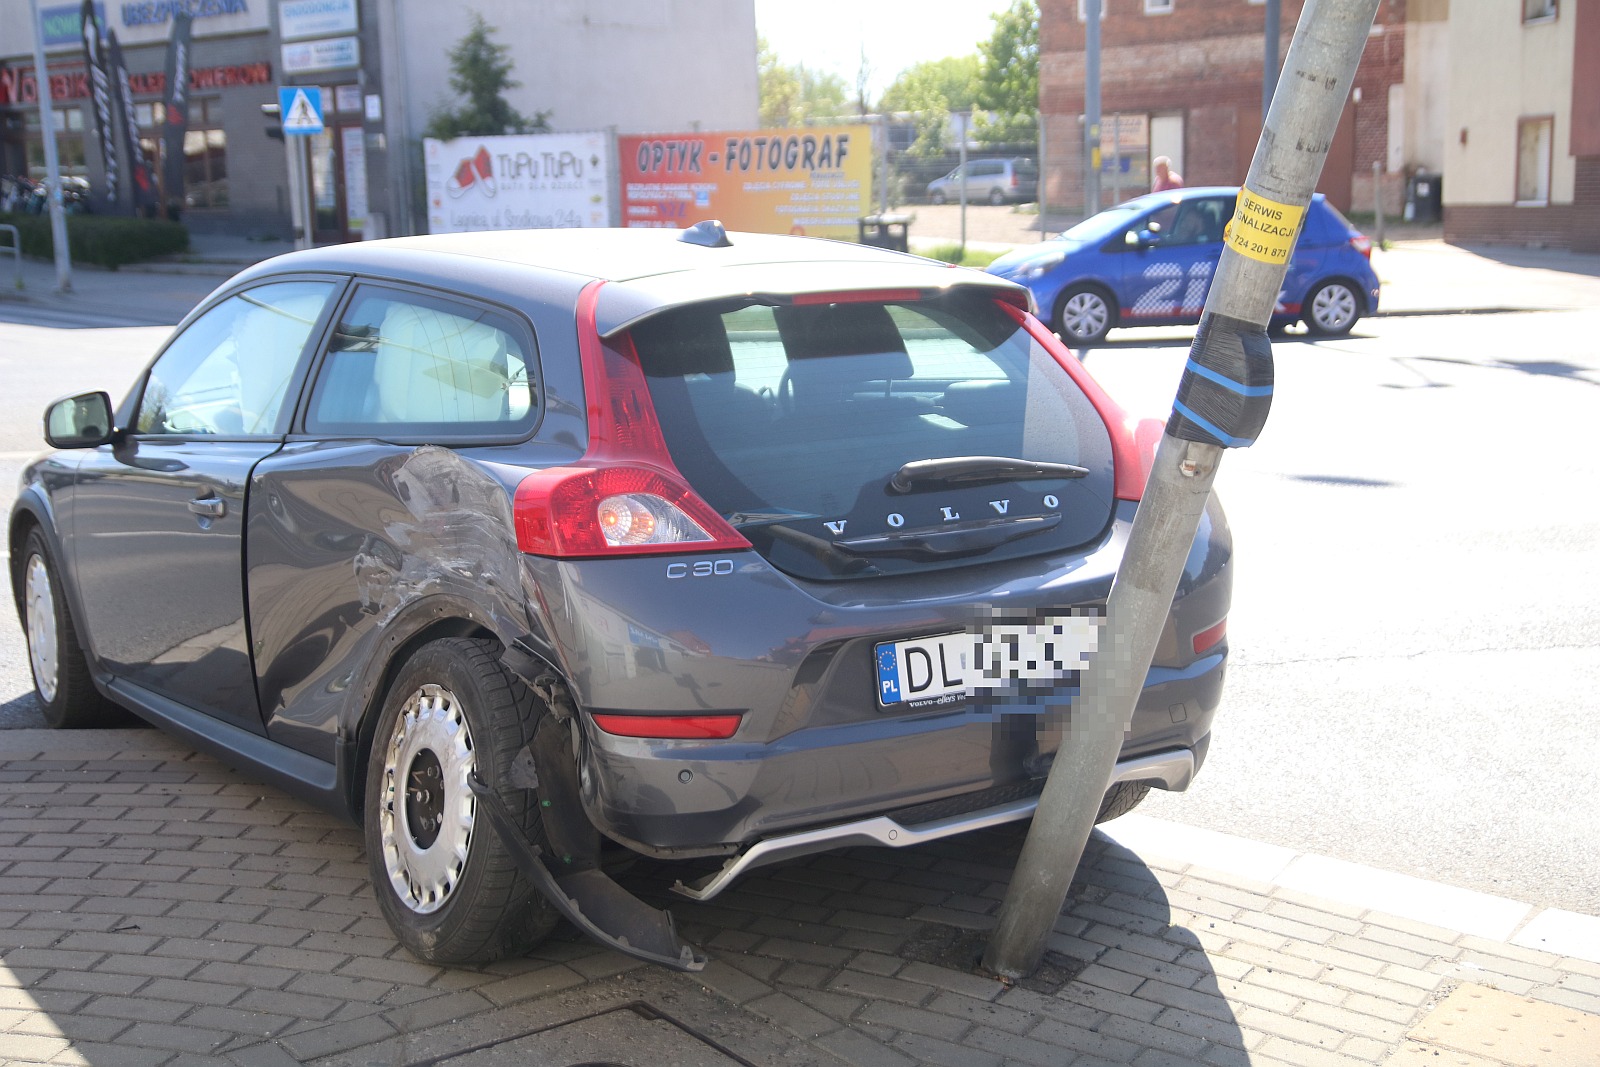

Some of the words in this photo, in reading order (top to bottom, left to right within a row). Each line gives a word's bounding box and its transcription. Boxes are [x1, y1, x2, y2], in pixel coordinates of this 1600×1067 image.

[637, 140, 704, 174] OPTYK
[725, 134, 849, 172] FOTOGRAF
[1243, 198, 1283, 220] SERWIS
[1234, 234, 1249, 248] 724
[1250, 242, 1268, 255] 201
[1270, 248, 1287, 258] 873
[824, 494, 1060, 536] VOLVO
[882, 680, 898, 694] PL
